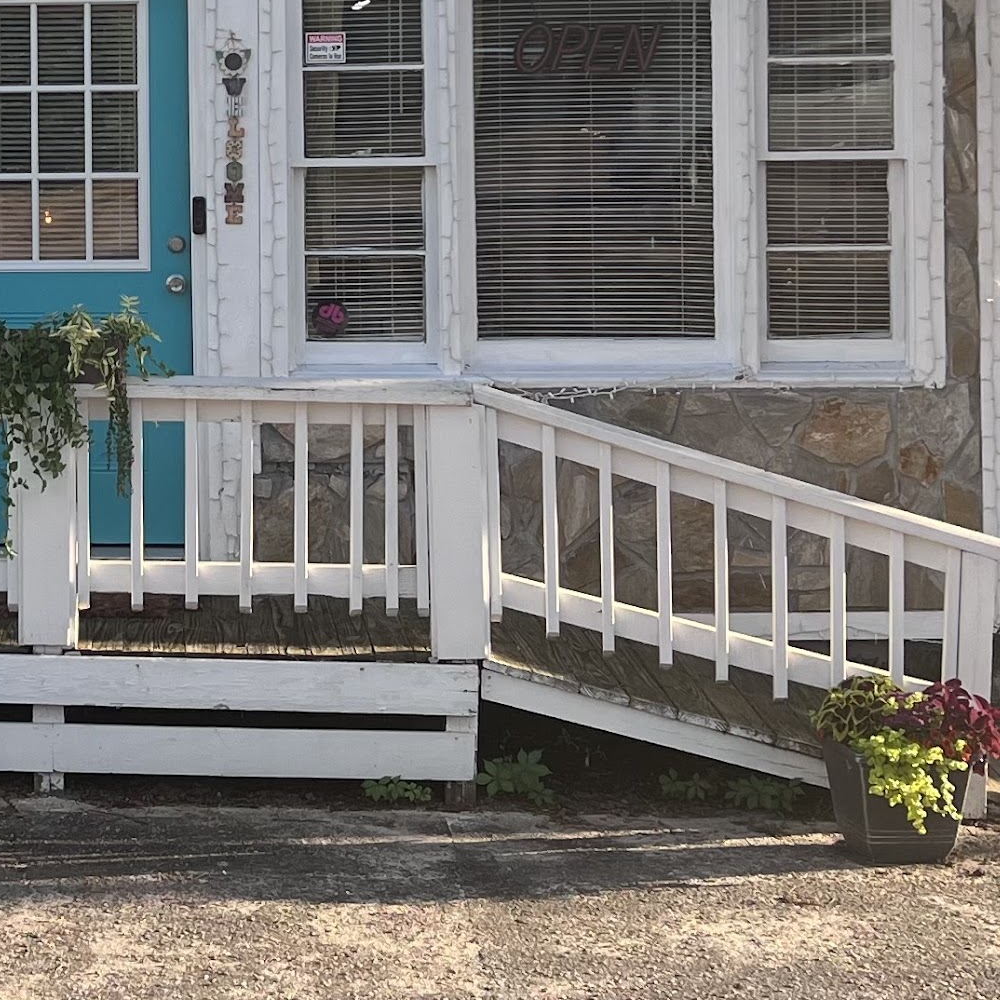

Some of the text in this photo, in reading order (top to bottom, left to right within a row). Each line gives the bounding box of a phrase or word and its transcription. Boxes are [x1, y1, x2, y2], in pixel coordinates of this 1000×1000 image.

[308, 35, 343, 43] WARNING
[514, 24, 664, 72] OPEN
[222, 78, 246, 225] WELCOME
